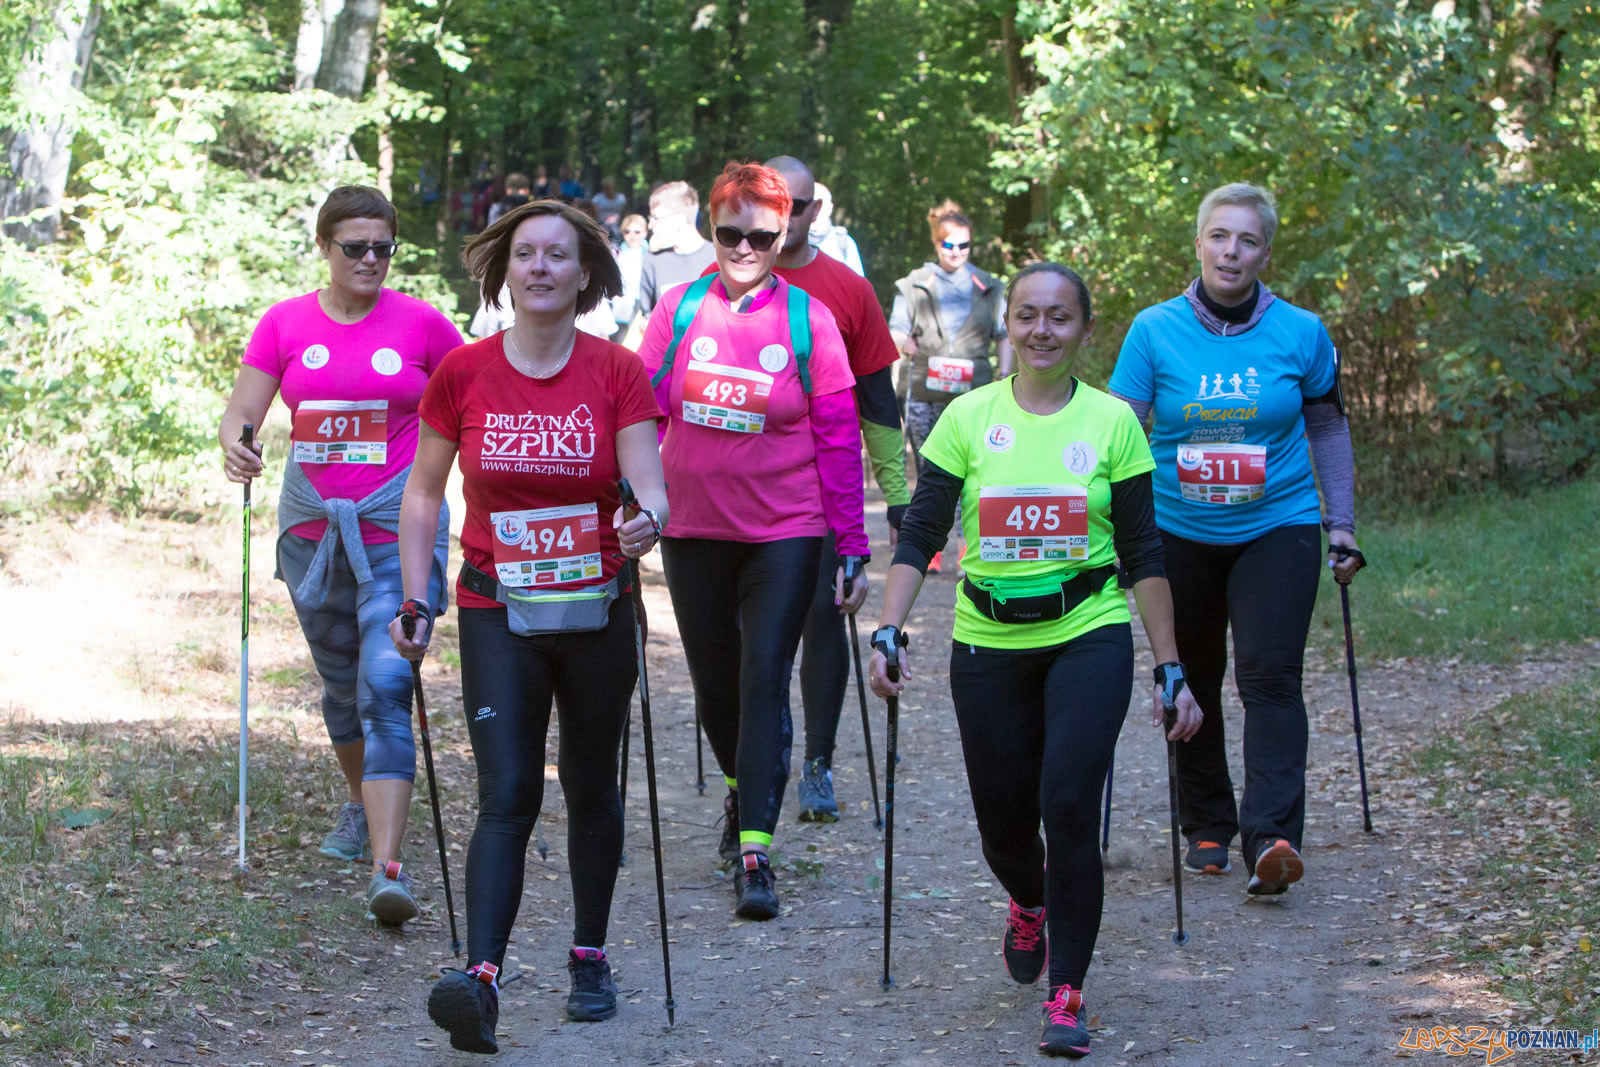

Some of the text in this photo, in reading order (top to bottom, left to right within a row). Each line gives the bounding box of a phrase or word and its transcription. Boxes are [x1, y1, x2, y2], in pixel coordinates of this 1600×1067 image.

[702, 379, 748, 406] 493
[317, 416, 361, 438] 491
[484, 410, 577, 431] DRUŻYNA
[481, 431, 596, 458] SZPIKU
[481, 460, 590, 478] www.darszpiku.pl
[1199, 459, 1240, 481] 511
[1005, 505, 1060, 531] 495
[520, 525, 575, 555] 494
